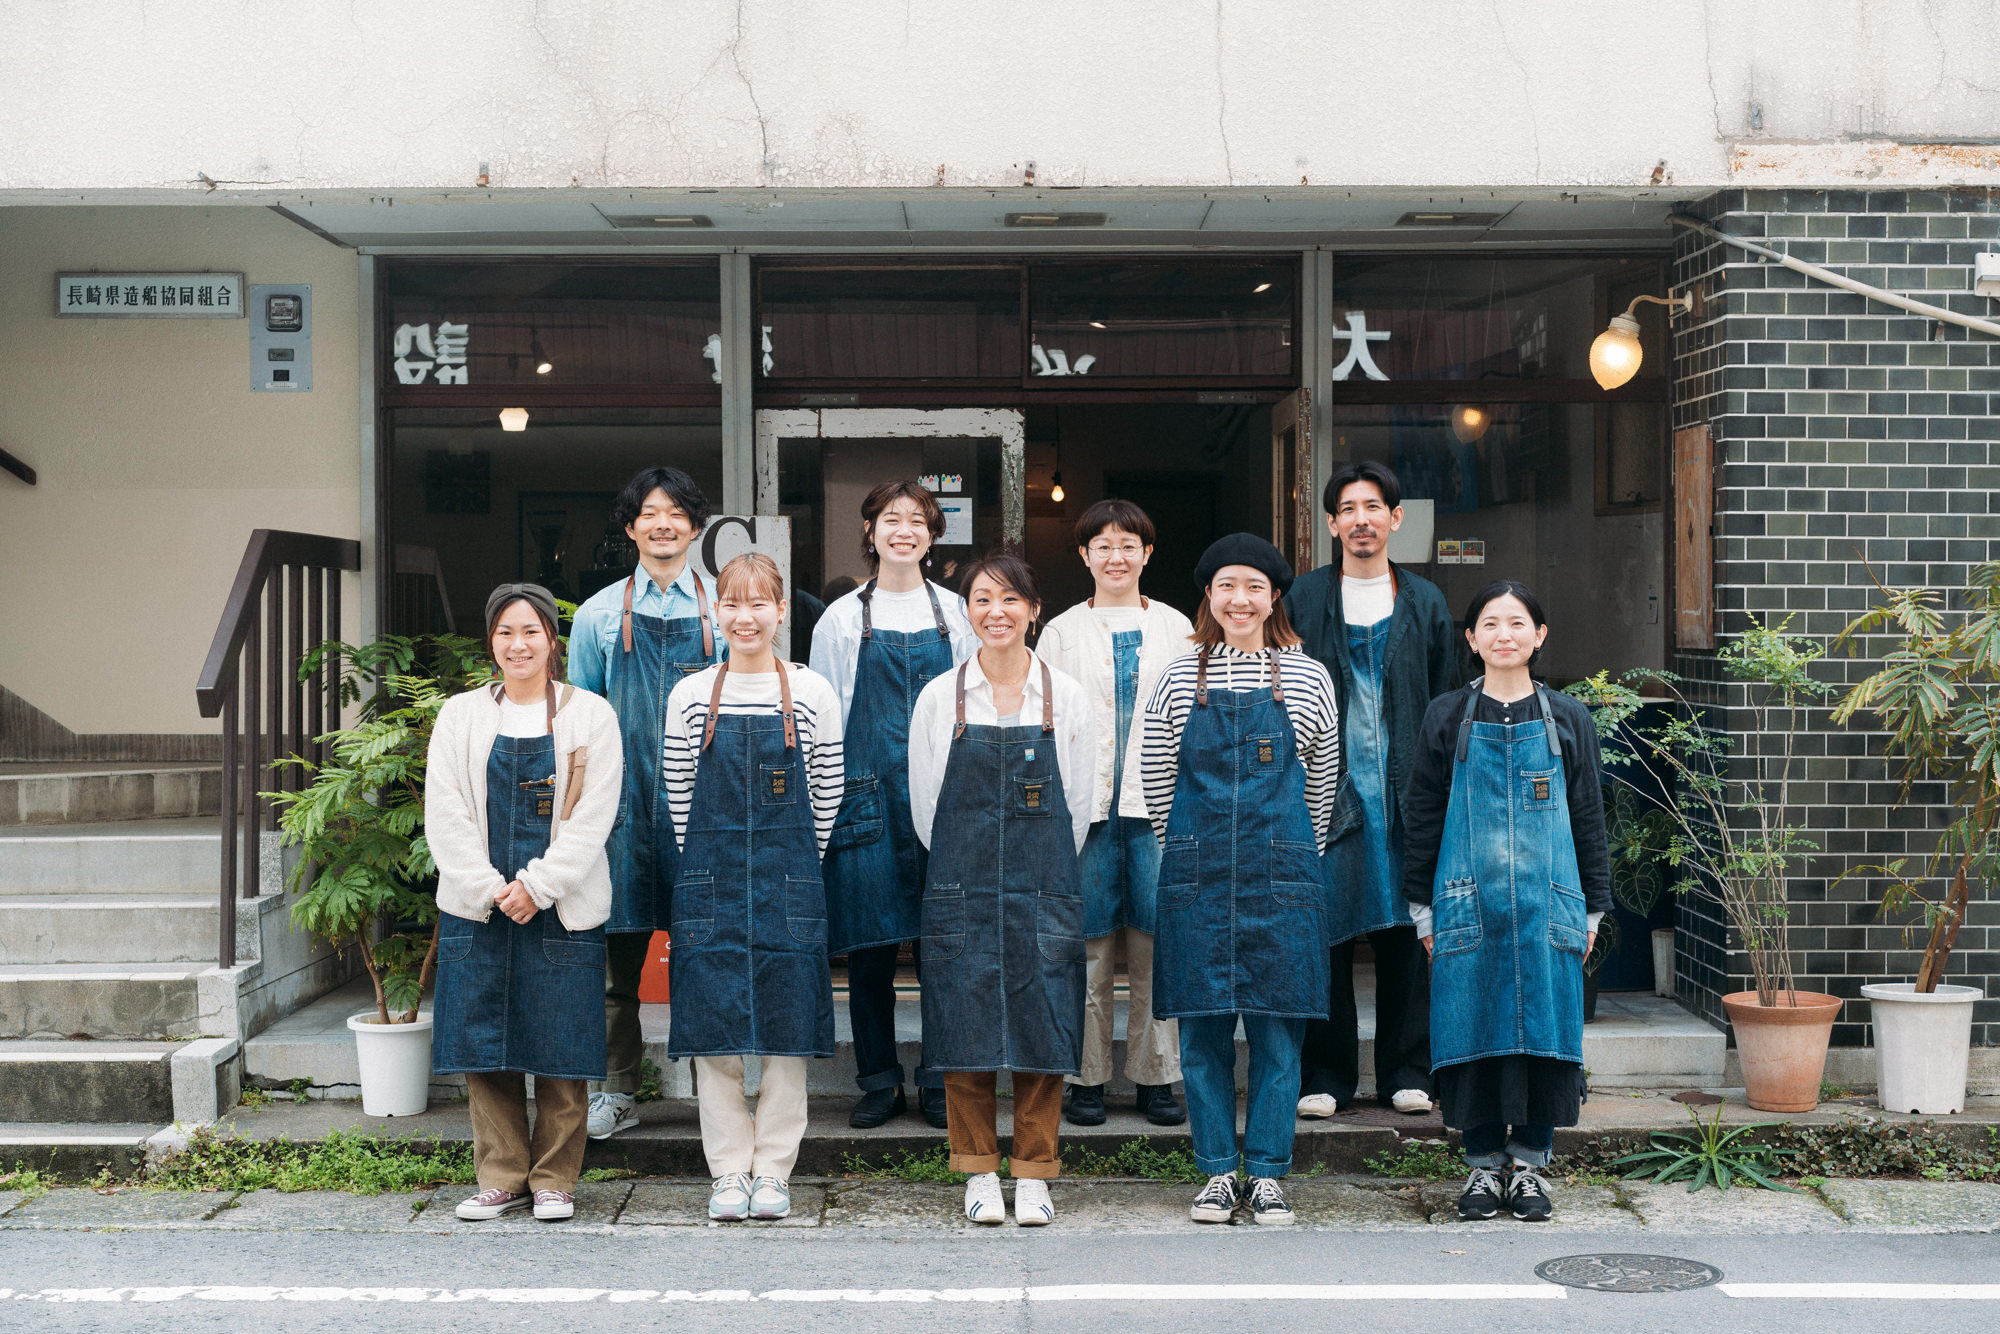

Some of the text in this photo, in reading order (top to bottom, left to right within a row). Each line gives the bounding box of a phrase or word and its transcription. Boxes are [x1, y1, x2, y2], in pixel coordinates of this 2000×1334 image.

[66, 285, 232, 307] 長崎県造船協同組合
